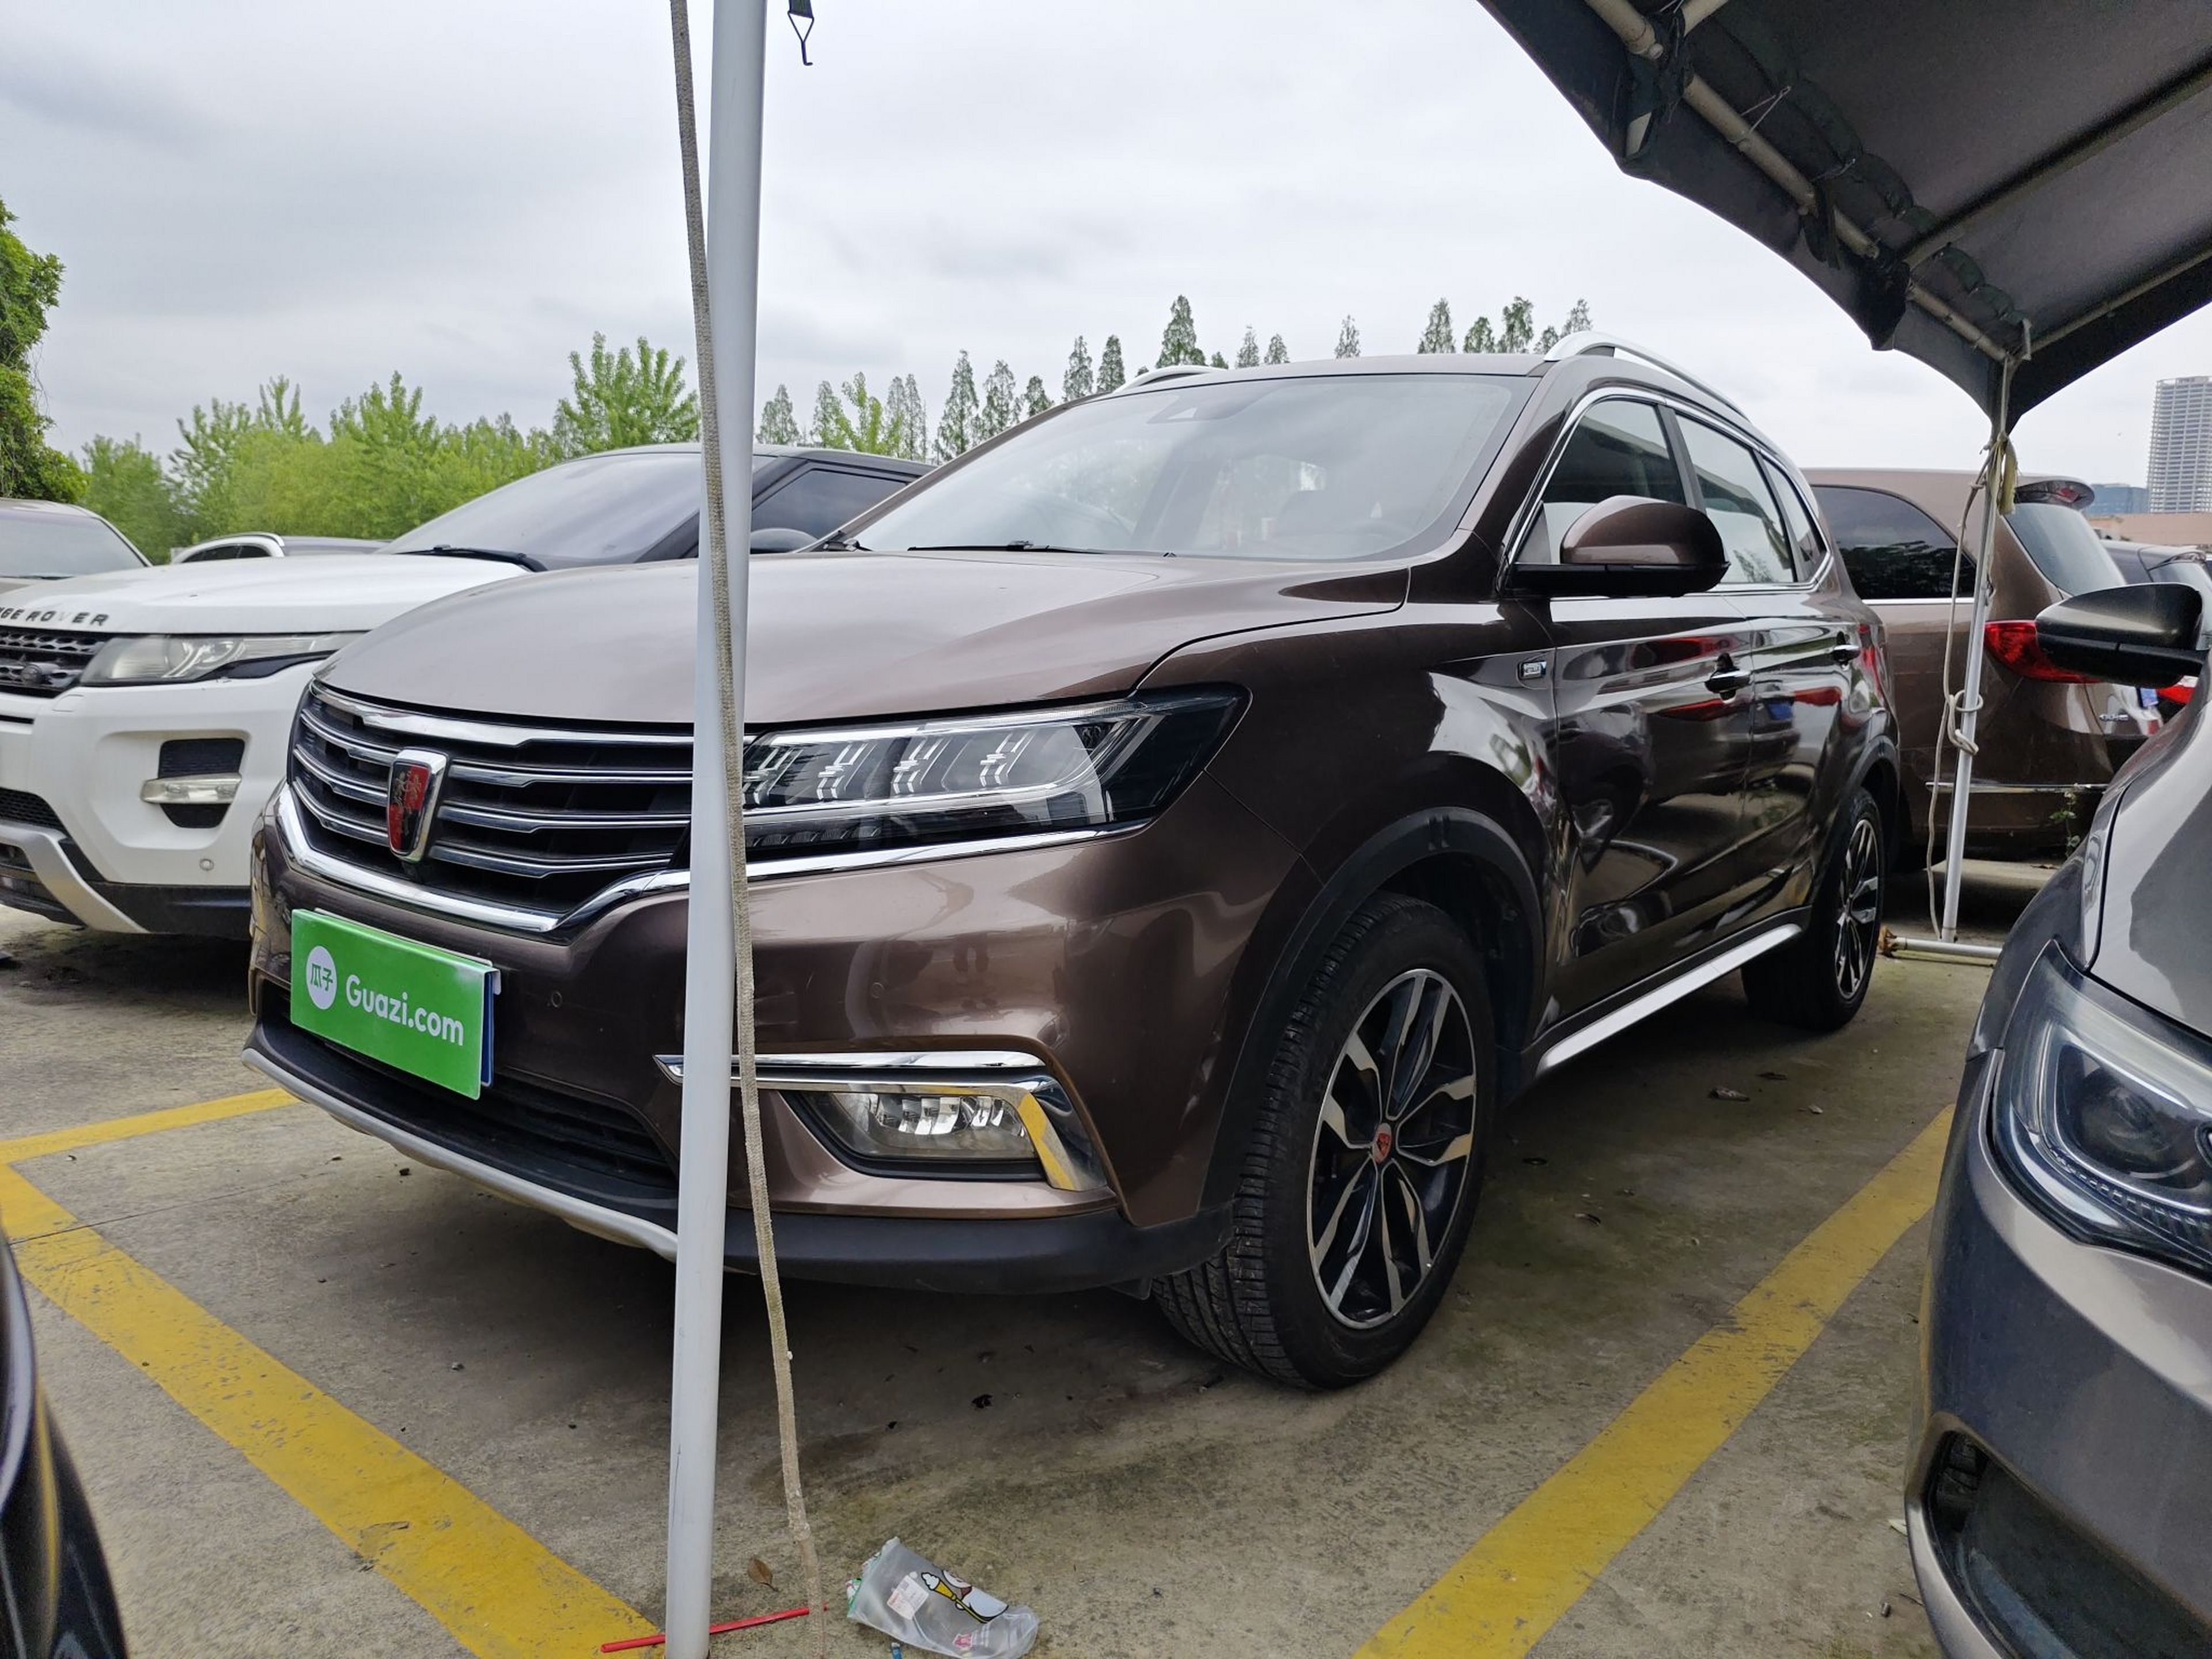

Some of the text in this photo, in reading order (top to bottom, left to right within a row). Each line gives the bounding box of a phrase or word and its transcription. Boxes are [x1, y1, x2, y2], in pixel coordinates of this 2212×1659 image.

[26, 611, 109, 626] ROER
[310, 963, 334, 991] 瓜子
[346, 974, 464, 1046] Guazi.com
